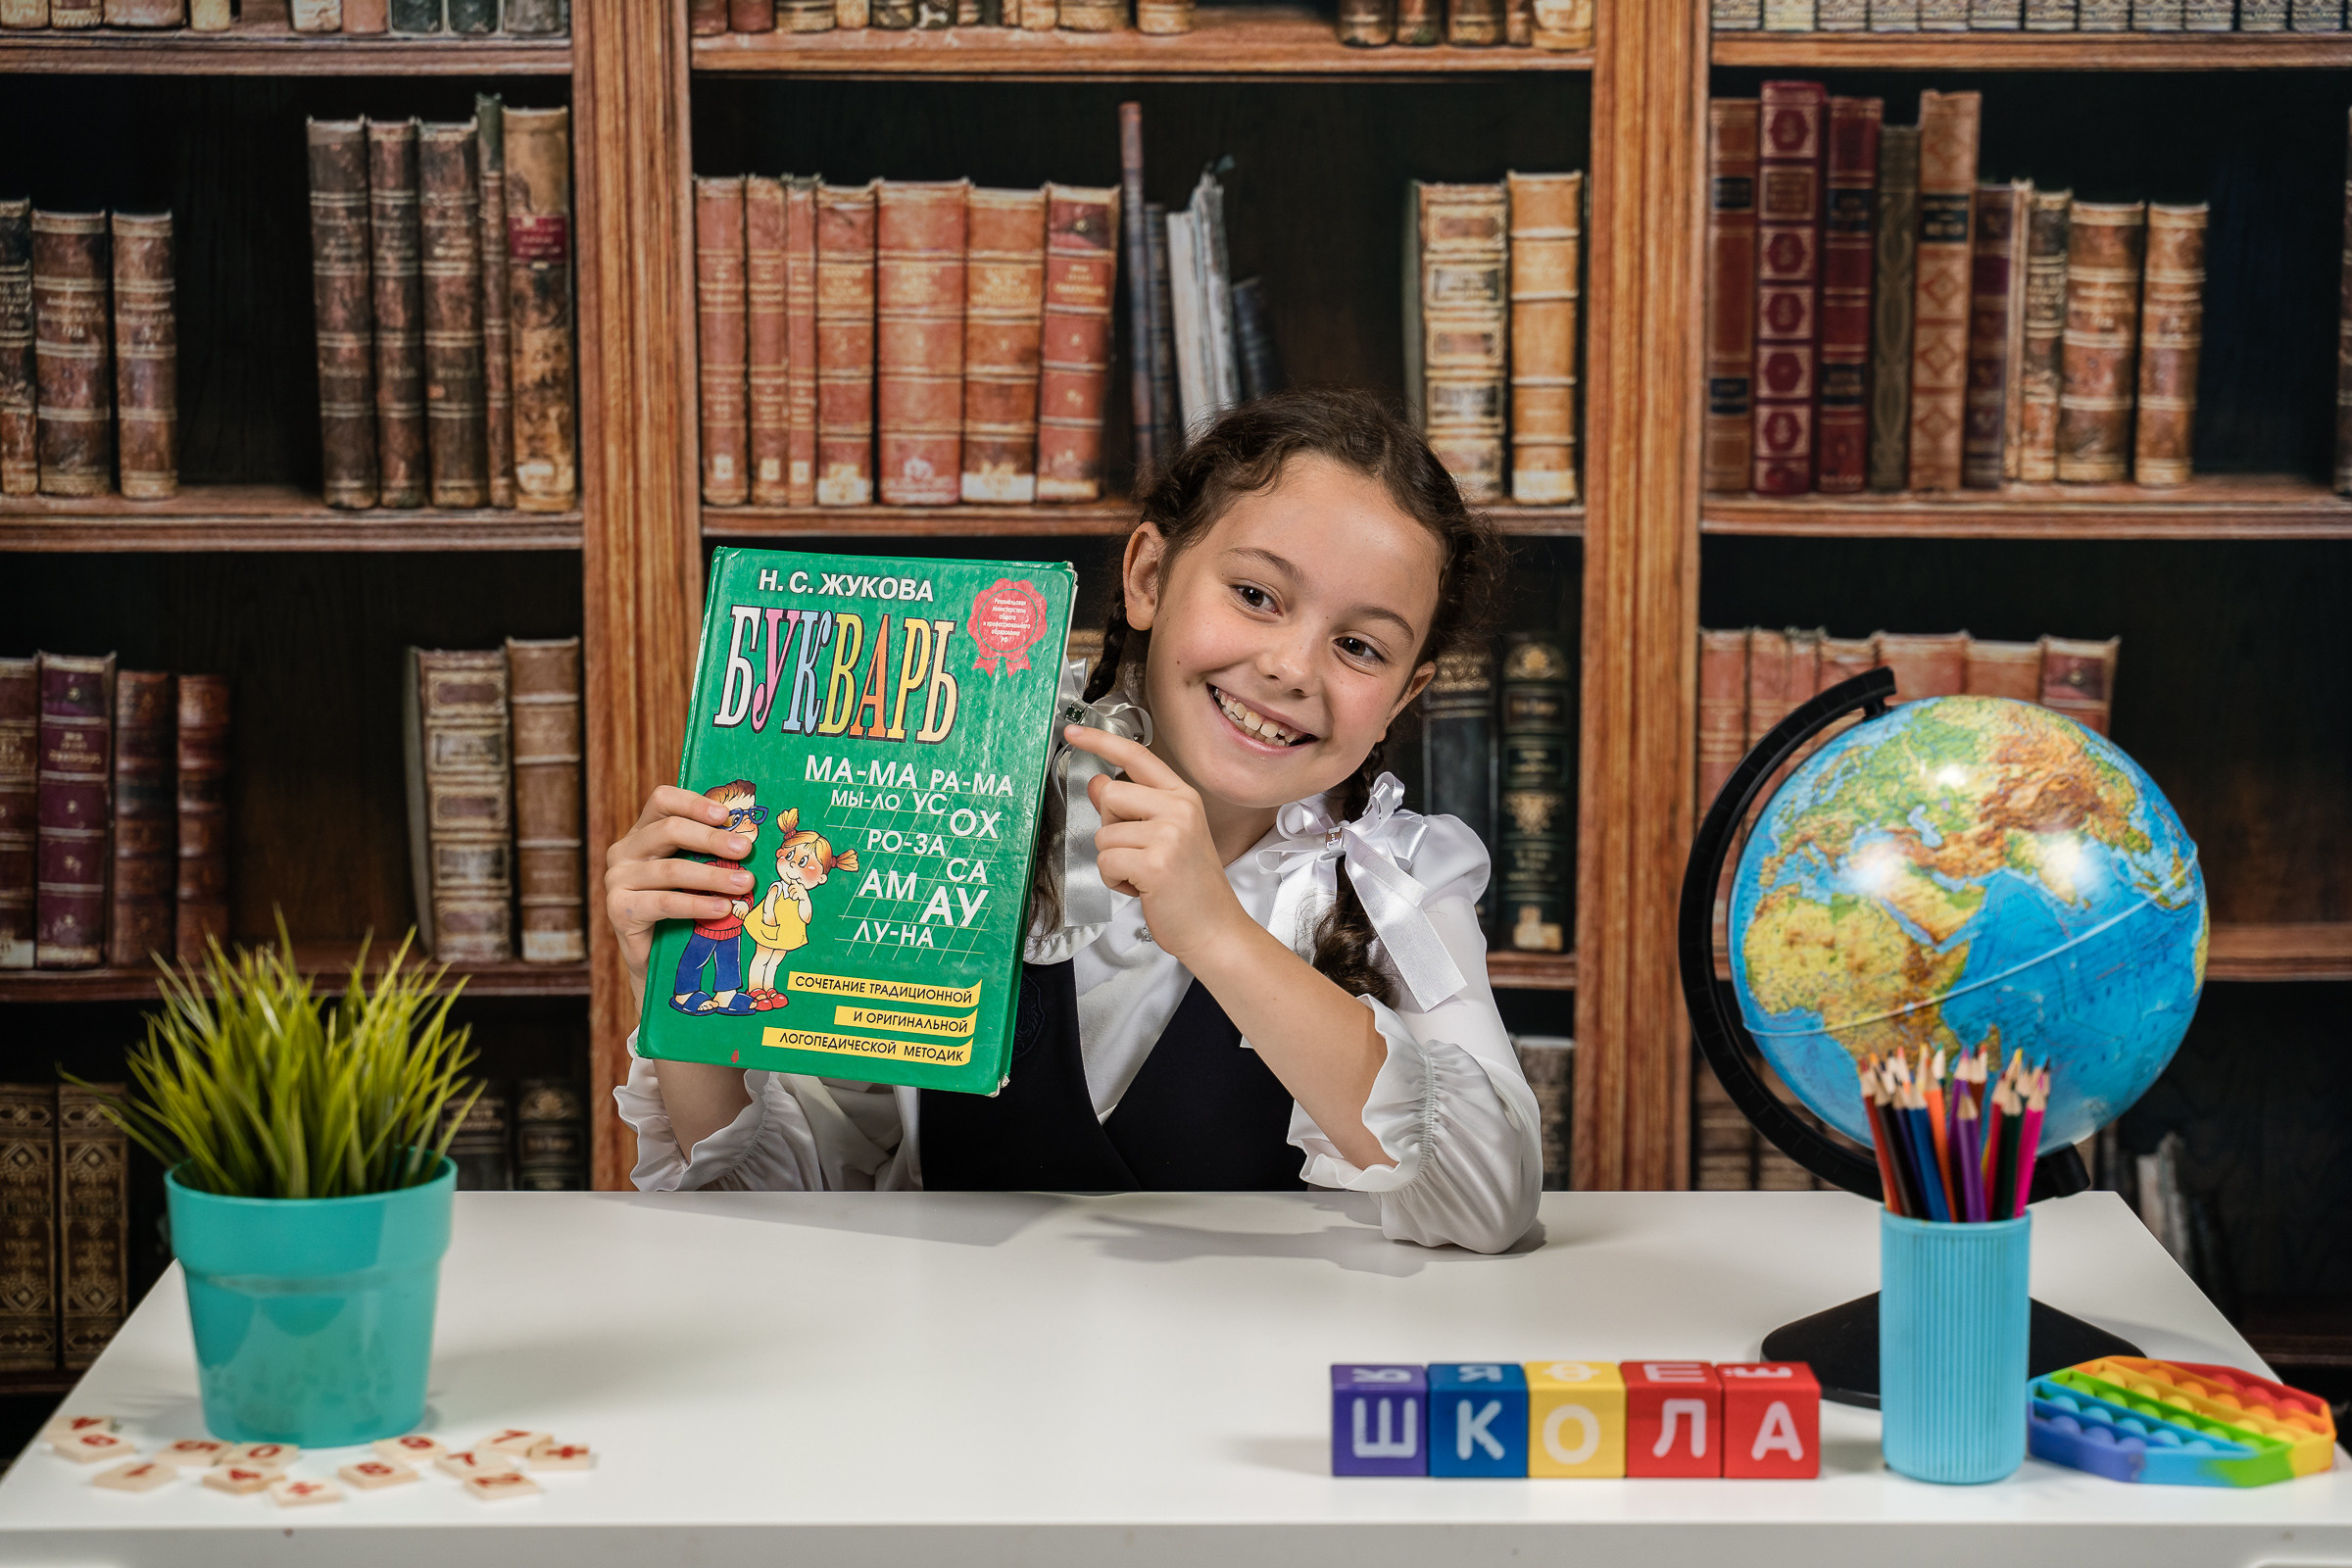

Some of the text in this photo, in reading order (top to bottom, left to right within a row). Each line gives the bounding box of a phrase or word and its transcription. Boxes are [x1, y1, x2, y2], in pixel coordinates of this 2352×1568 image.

[759, 568, 934, 602] Н. С. ЖУКОВА
[712, 605, 959, 744] БУКВАРЬ
[805, 755, 1013, 797] МА-МА РА-МА
[831, 789, 948, 814] МЫ-ЛО УС
[950, 808, 1002, 839] ОХ
[866, 829, 946, 857] РО-ЗА
[858, 868, 917, 901] АМ
[946, 858, 988, 884] СА
[918, 885, 990, 927] АУ
[853, 920, 934, 948] ЛУ-НА
[795, 975, 973, 1004] СОЧЕТАНИЕ ТРАДИЦИОННОЙ
[853, 1011, 968, 1033] И ОРИГИНАЛЬНОЙ
[779, 1033, 964, 1062] ЛОГОПЕДИЧЕСКОЙ МЕТОДИК
[1352, 1397, 1804, 1464] ШКОЛА
